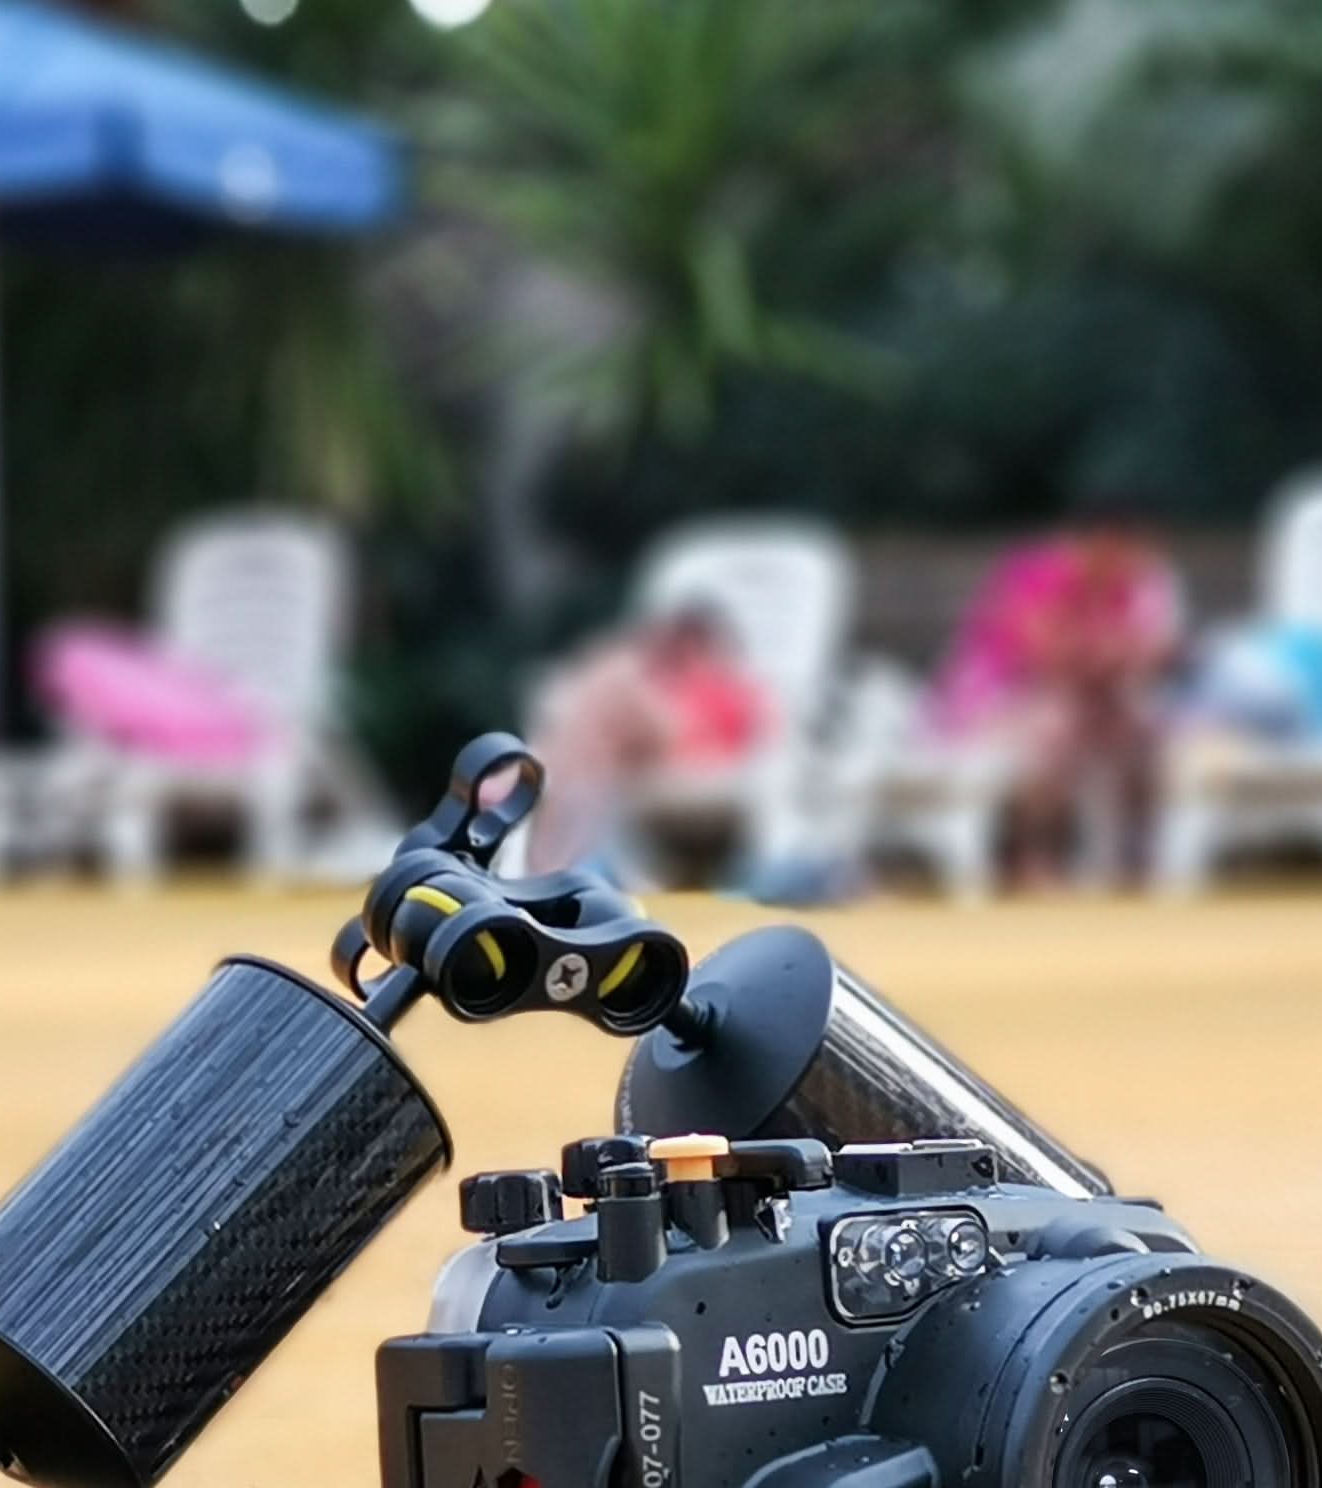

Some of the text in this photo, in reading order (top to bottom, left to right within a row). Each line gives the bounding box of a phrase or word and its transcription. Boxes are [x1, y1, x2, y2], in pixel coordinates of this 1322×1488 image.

[719, 1329, 829, 1377] A6000
[702, 1373, 847, 1406] WATERPROOF CASE
